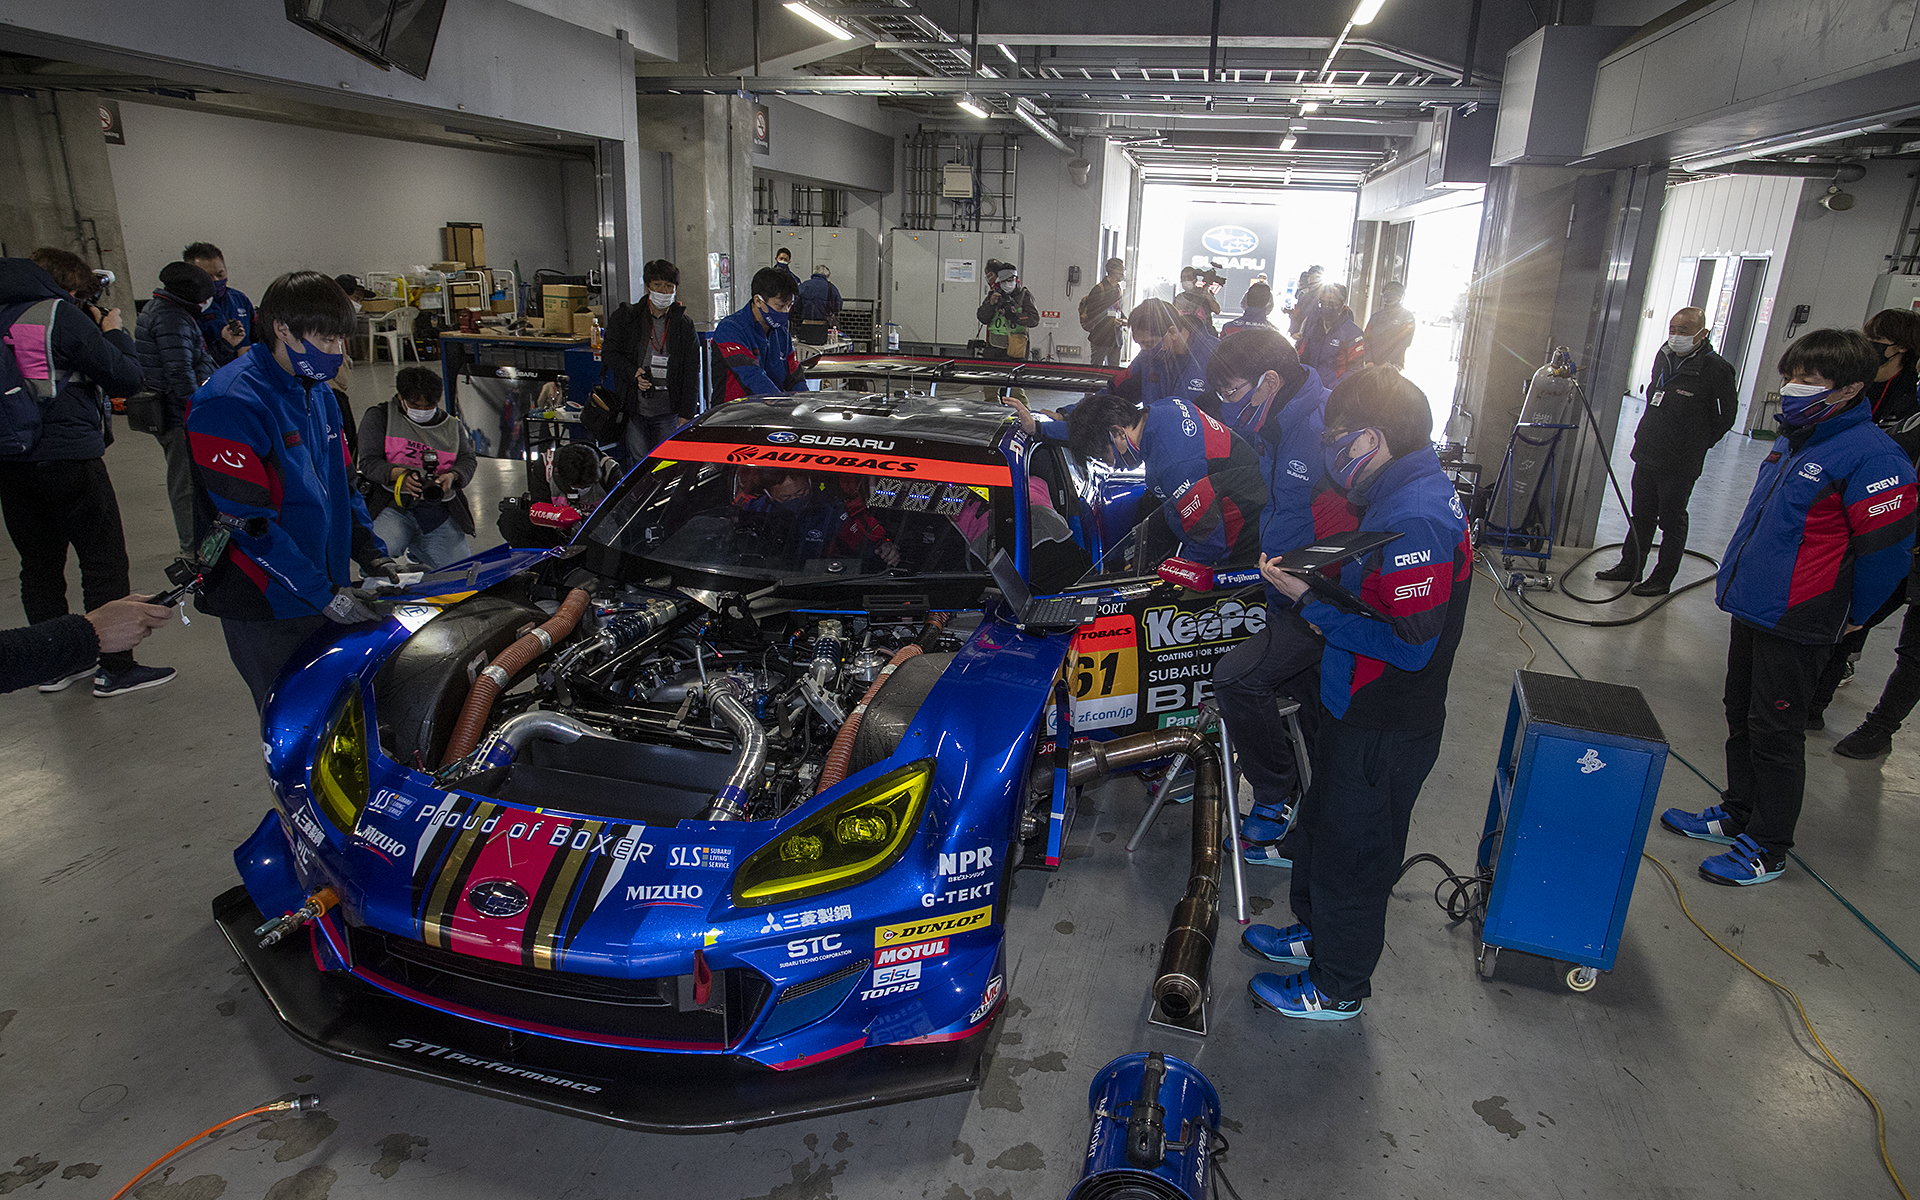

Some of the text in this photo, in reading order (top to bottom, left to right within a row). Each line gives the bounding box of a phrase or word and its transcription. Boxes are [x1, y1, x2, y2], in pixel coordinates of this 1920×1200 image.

[1191, 255, 1266, 271] SUBARU
[799, 434, 895, 450] SUBARU
[756, 451, 919, 472] AUTOBACS
[1286, 469, 1310, 481] SUBARU
[1798, 470, 1820, 483] SUBARU
[1865, 475, 1900, 494] CREW
[1172, 479, 1192, 499] CREW
[1394, 550, 1431, 567] CREW
[1228, 573, 1260, 584] Fujikura
[1096, 602, 1127, 615] PORT
[1078, 627, 1132, 640] TOBACS
[1145, 602, 1267, 648] KeePe
[1157, 650, 1194, 662] COATING
[1076, 652, 1119, 698] 61
[1148, 663, 1212, 682] SUBARU
[1078, 707, 1134, 722] zf.com/jp
[369, 789, 395, 809] SLS
[361, 824, 407, 857] MIZUHO
[414, 804, 656, 863] Proud of BOXER
[669, 846, 702, 867] SLS
[708, 854, 729, 862] LIVING
[709, 847, 732, 856] SUBARU
[938, 846, 993, 876] NPR
[708, 861, 731, 869] SERVICE
[625, 884, 703, 901] MIZUHO
[921, 881, 994, 908] G-TEKT
[782, 904, 853, 930] 三菱製鋼
[899, 912, 986, 938] DUNLOP
[787, 933, 843, 958] STC
[877, 940, 946, 965] MOTUL
[779, 949, 852, 968] SUBARU TECHNO CORPORATION
[388, 1038, 450, 1057] STI
[1088, 1120, 1102, 1158] SPORT
